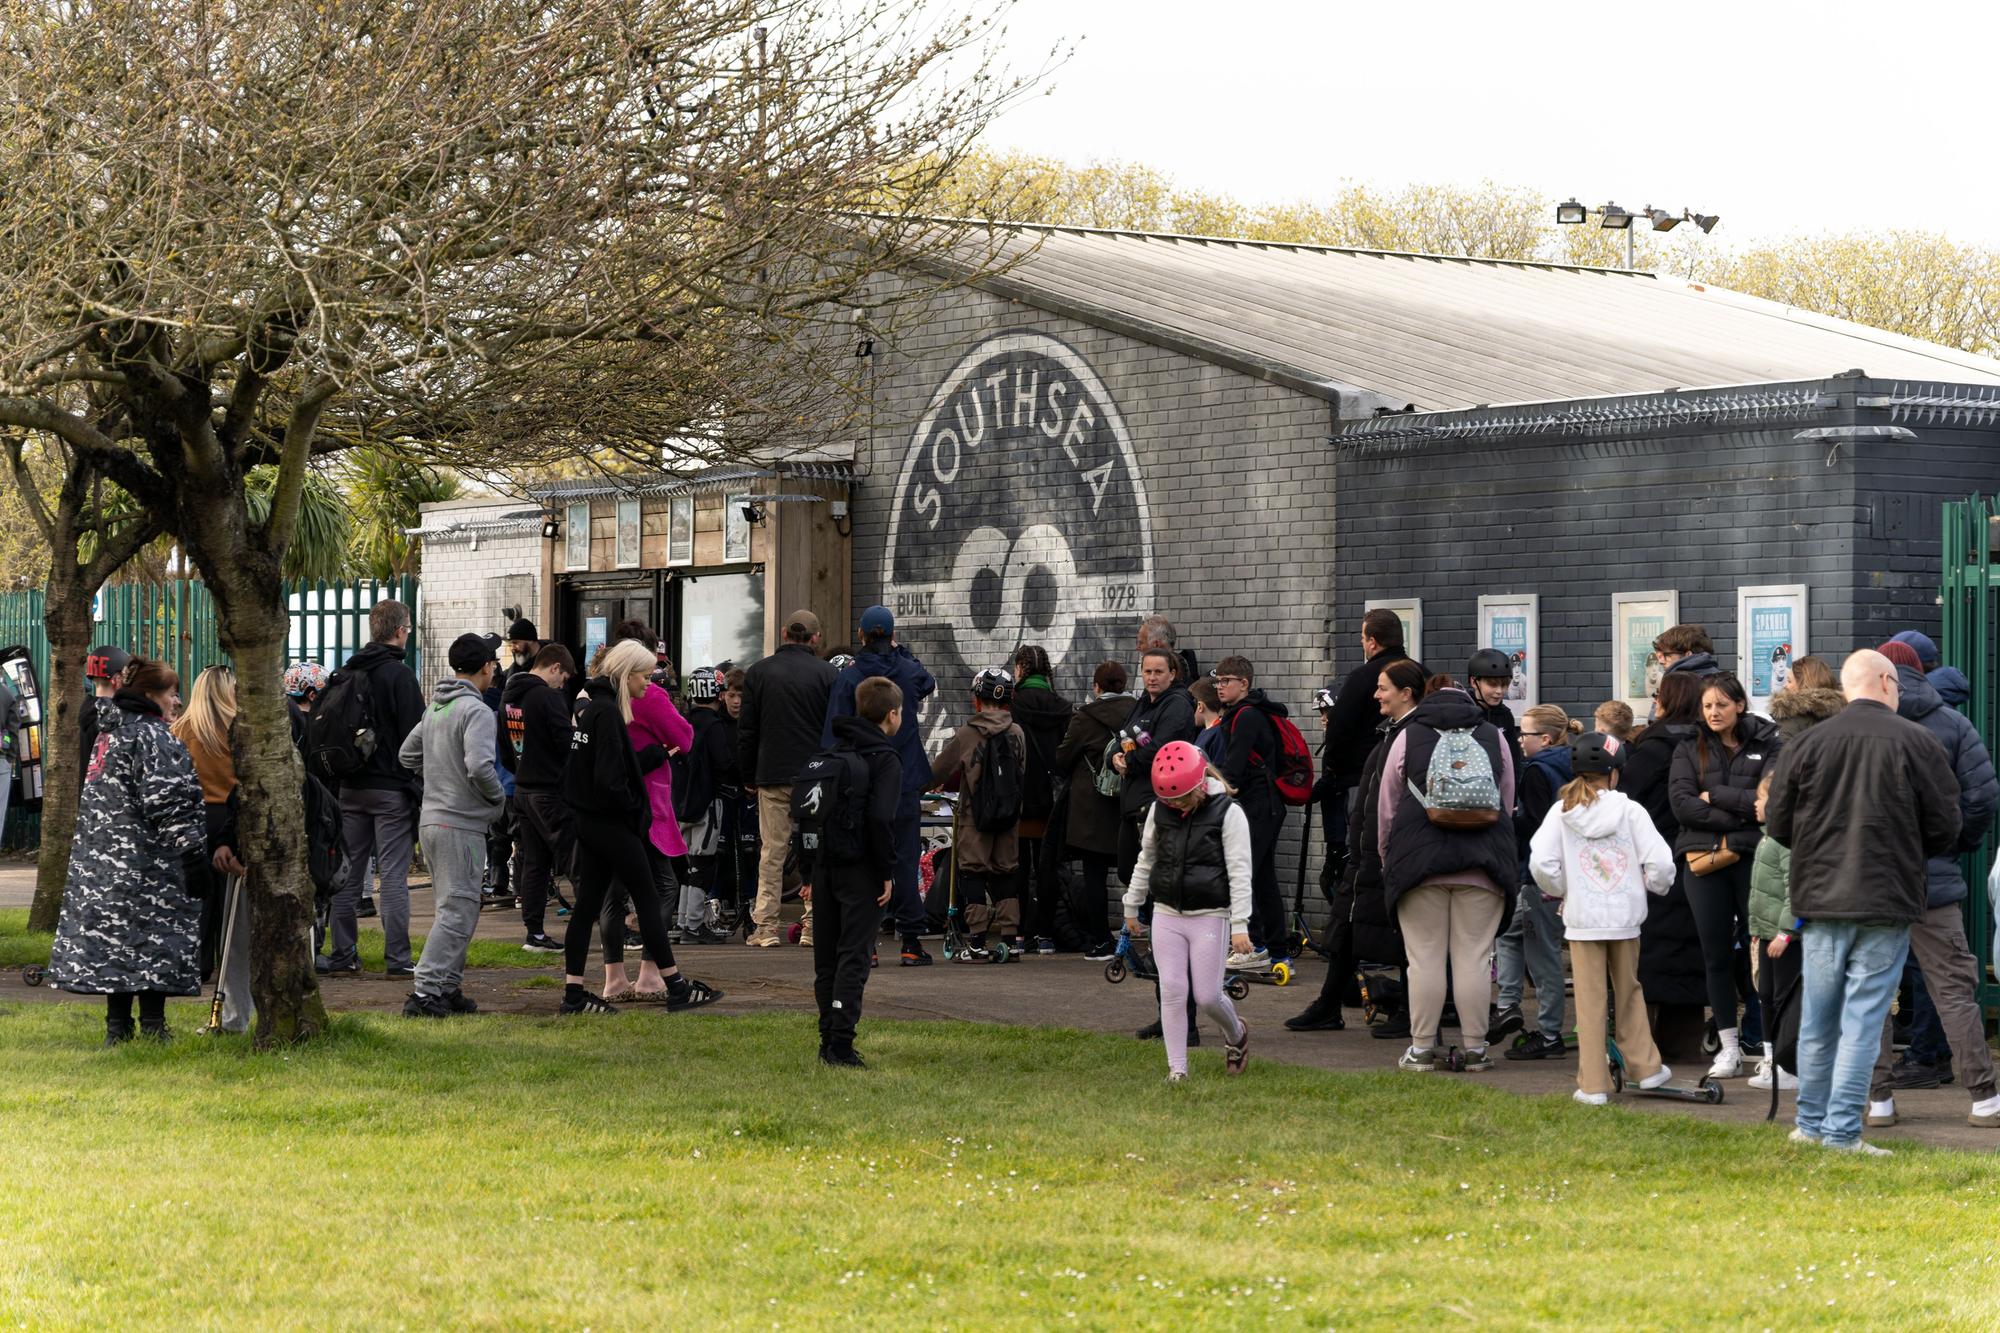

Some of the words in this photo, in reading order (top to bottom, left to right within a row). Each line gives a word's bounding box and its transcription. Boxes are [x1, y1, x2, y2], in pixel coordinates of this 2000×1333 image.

[914, 368, 1114, 530] SOUTHSEA
[897, 592, 936, 617] BUILT
[1100, 585, 1137, 611] 1978
